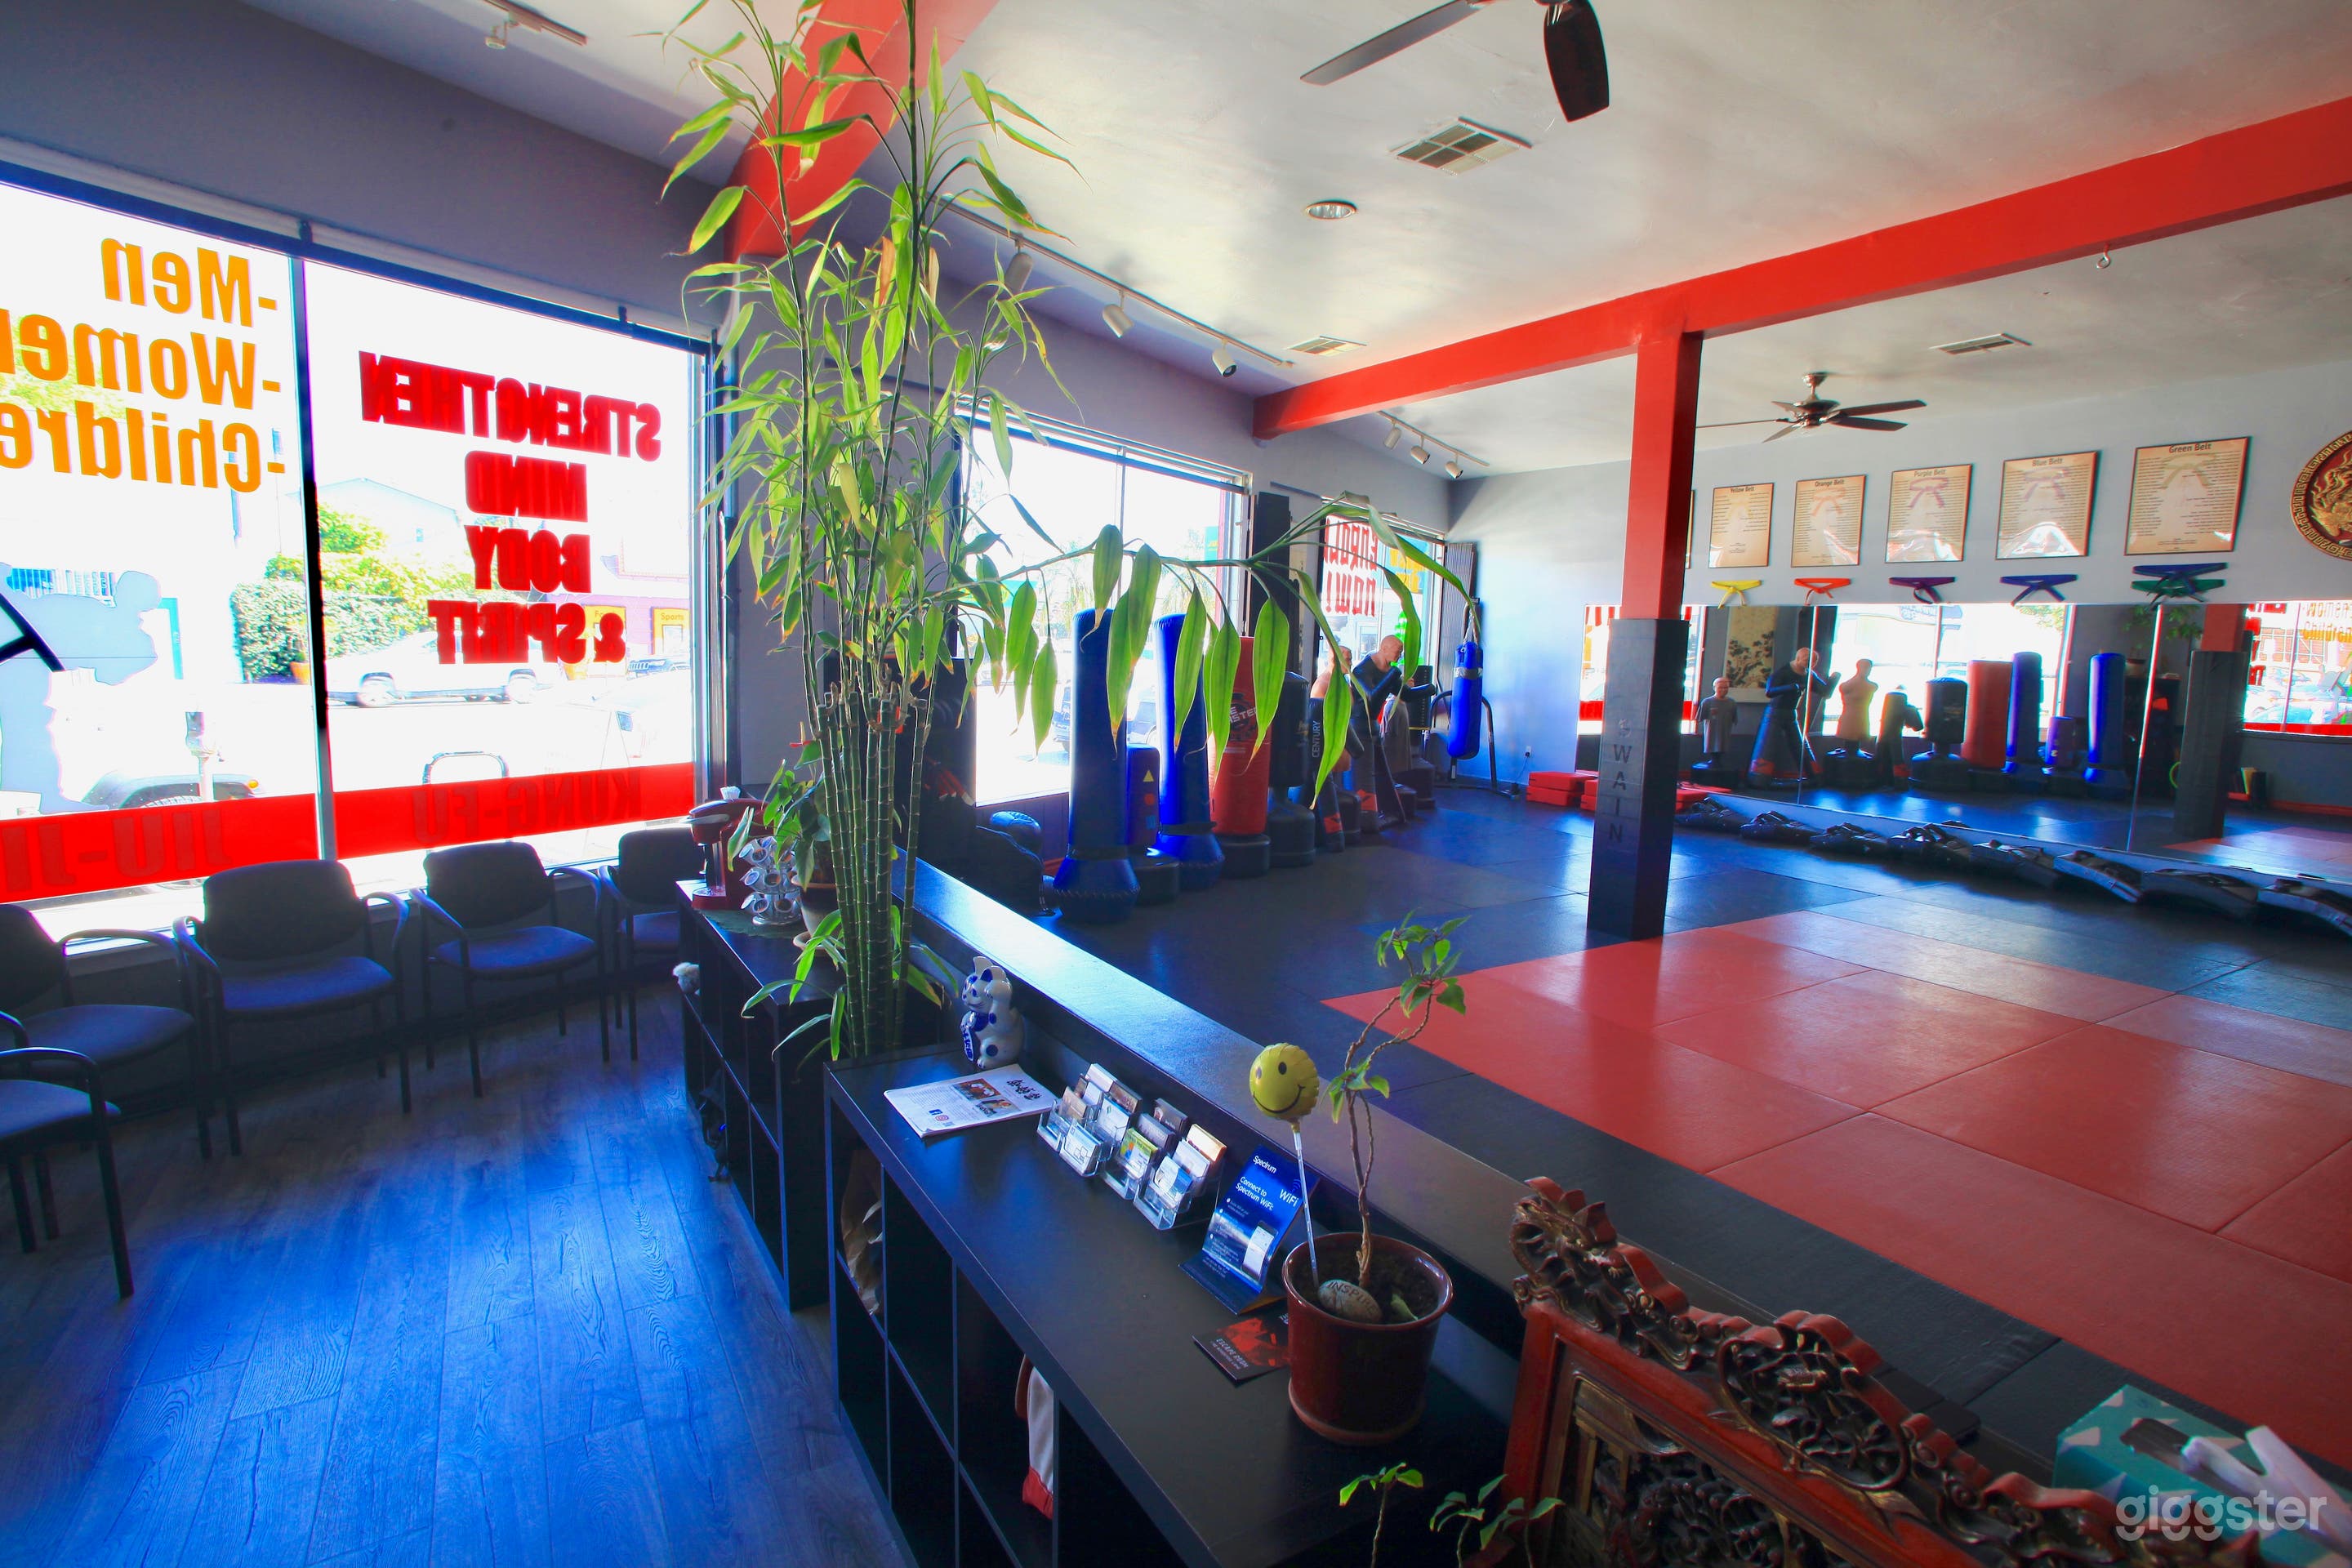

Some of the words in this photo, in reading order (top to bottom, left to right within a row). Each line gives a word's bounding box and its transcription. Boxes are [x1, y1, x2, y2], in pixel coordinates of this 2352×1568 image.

[2168, 445, 2193, 453] Green
[2194, 443, 2212, 451] Belt
[1312, 719, 1321, 758] CENTURY
[1608, 718, 1633, 844] SWAIN
[1252, 1155, 1277, 1174] Spectrum
[1235, 1183, 1260, 1202] Spectrum
[1240, 1176, 1262, 1194] Connect
[1260, 1189, 1267, 1197] to
[1279, 1188, 1299, 1207] WiFi
